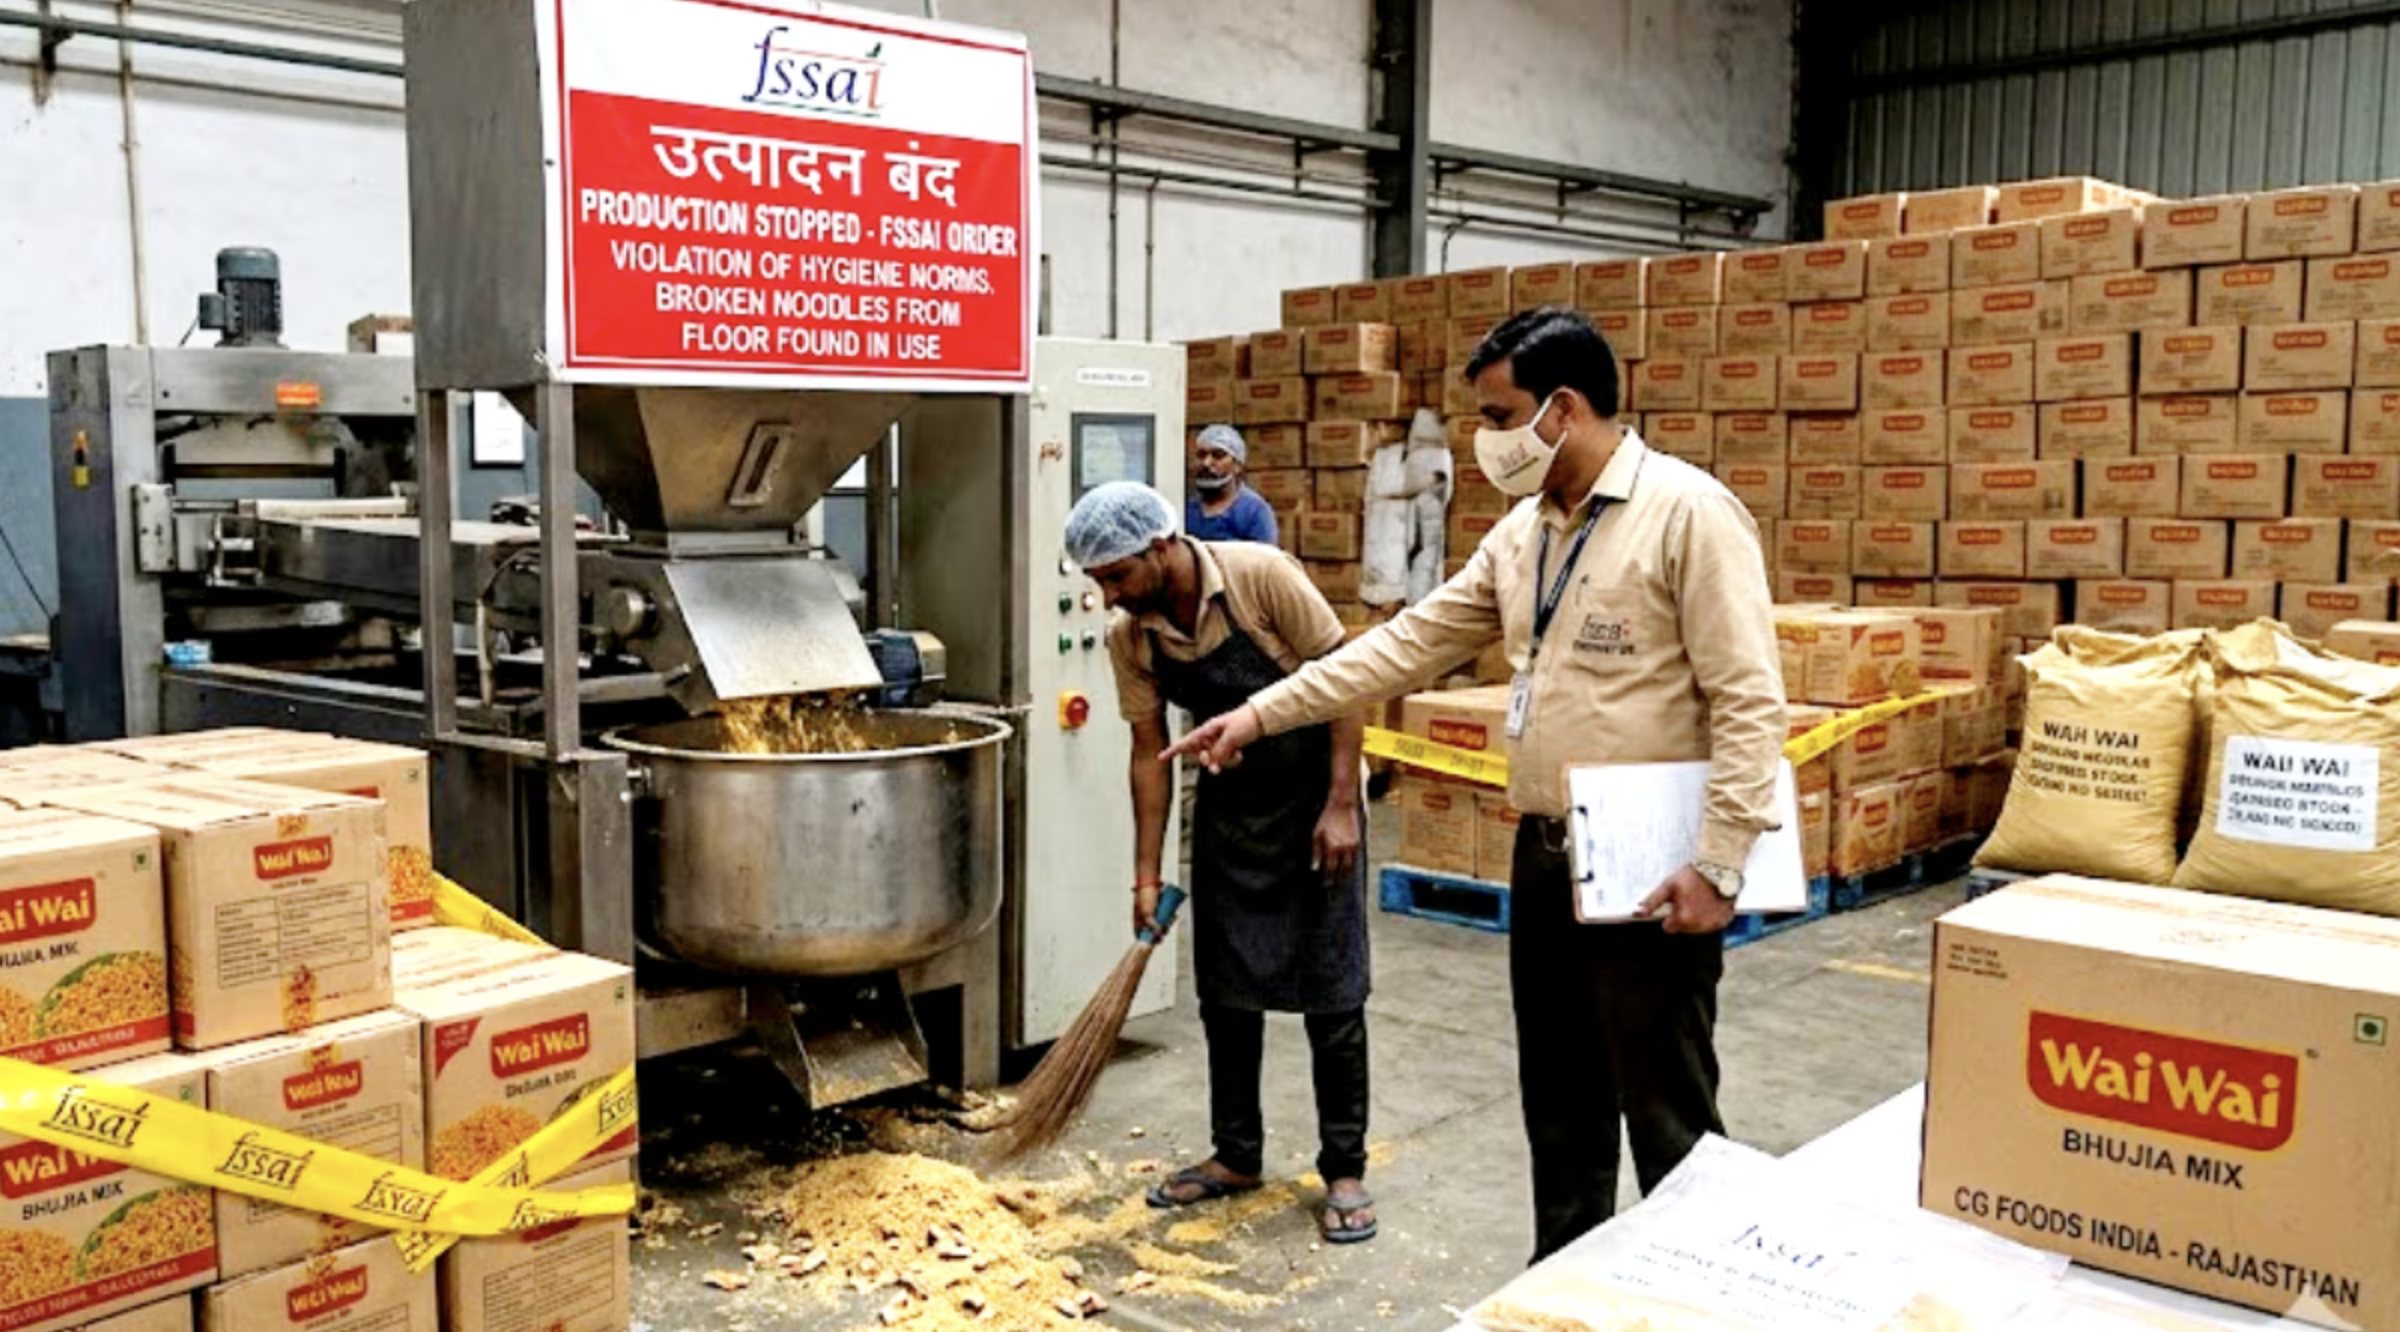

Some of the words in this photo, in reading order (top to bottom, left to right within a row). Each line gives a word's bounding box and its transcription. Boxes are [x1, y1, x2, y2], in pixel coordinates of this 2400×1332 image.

[742, 26, 886, 113] fssai
[650, 125, 866, 196] उत्पादन
[883, 141, 960, 207] बंद
[581, 188, 747, 235] PRODUCTION
[755, 204, 861, 244] STOPPED
[880, 215, 941, 251] FSSAI
[947, 221, 1017, 257] ORDER
[611, 239, 752, 278] VIOLATION
[759, 251, 793, 279] OF
[801, 255, 904, 288] HYGIENE
[655, 281, 766, 316] BROKEN
[773, 290, 889, 323] NOODLES
[896, 297, 961, 326] FROM
[682, 322, 770, 353] FLOOR
[777, 327, 860, 357] FOUND
[867, 332, 889, 359] IN
[897, 333, 941, 360] USE
[2095, 729, 2139, 749] WAI
[2301, 756, 2350, 777] WAI
[29, 889, 90, 926] Wai
[2041, 1038, 2153, 1104] Wai
[2159, 1060, 2281, 1128] Wai
[214, 1130, 315, 1190] fssai
[2062, 1127, 2175, 1175] BHUJIA
[2187, 1155, 2244, 1190] MIX
[22, 1188, 88, 1220] BHUJIA
[91, 1180, 124, 1199] MIX
[1954, 1186, 1989, 1217] CG
[1996, 1195, 2082, 1239] FOODS
[2091, 1219, 2162, 1259] INDIA
[2187, 1242, 2360, 1307] RAJASTHAN
